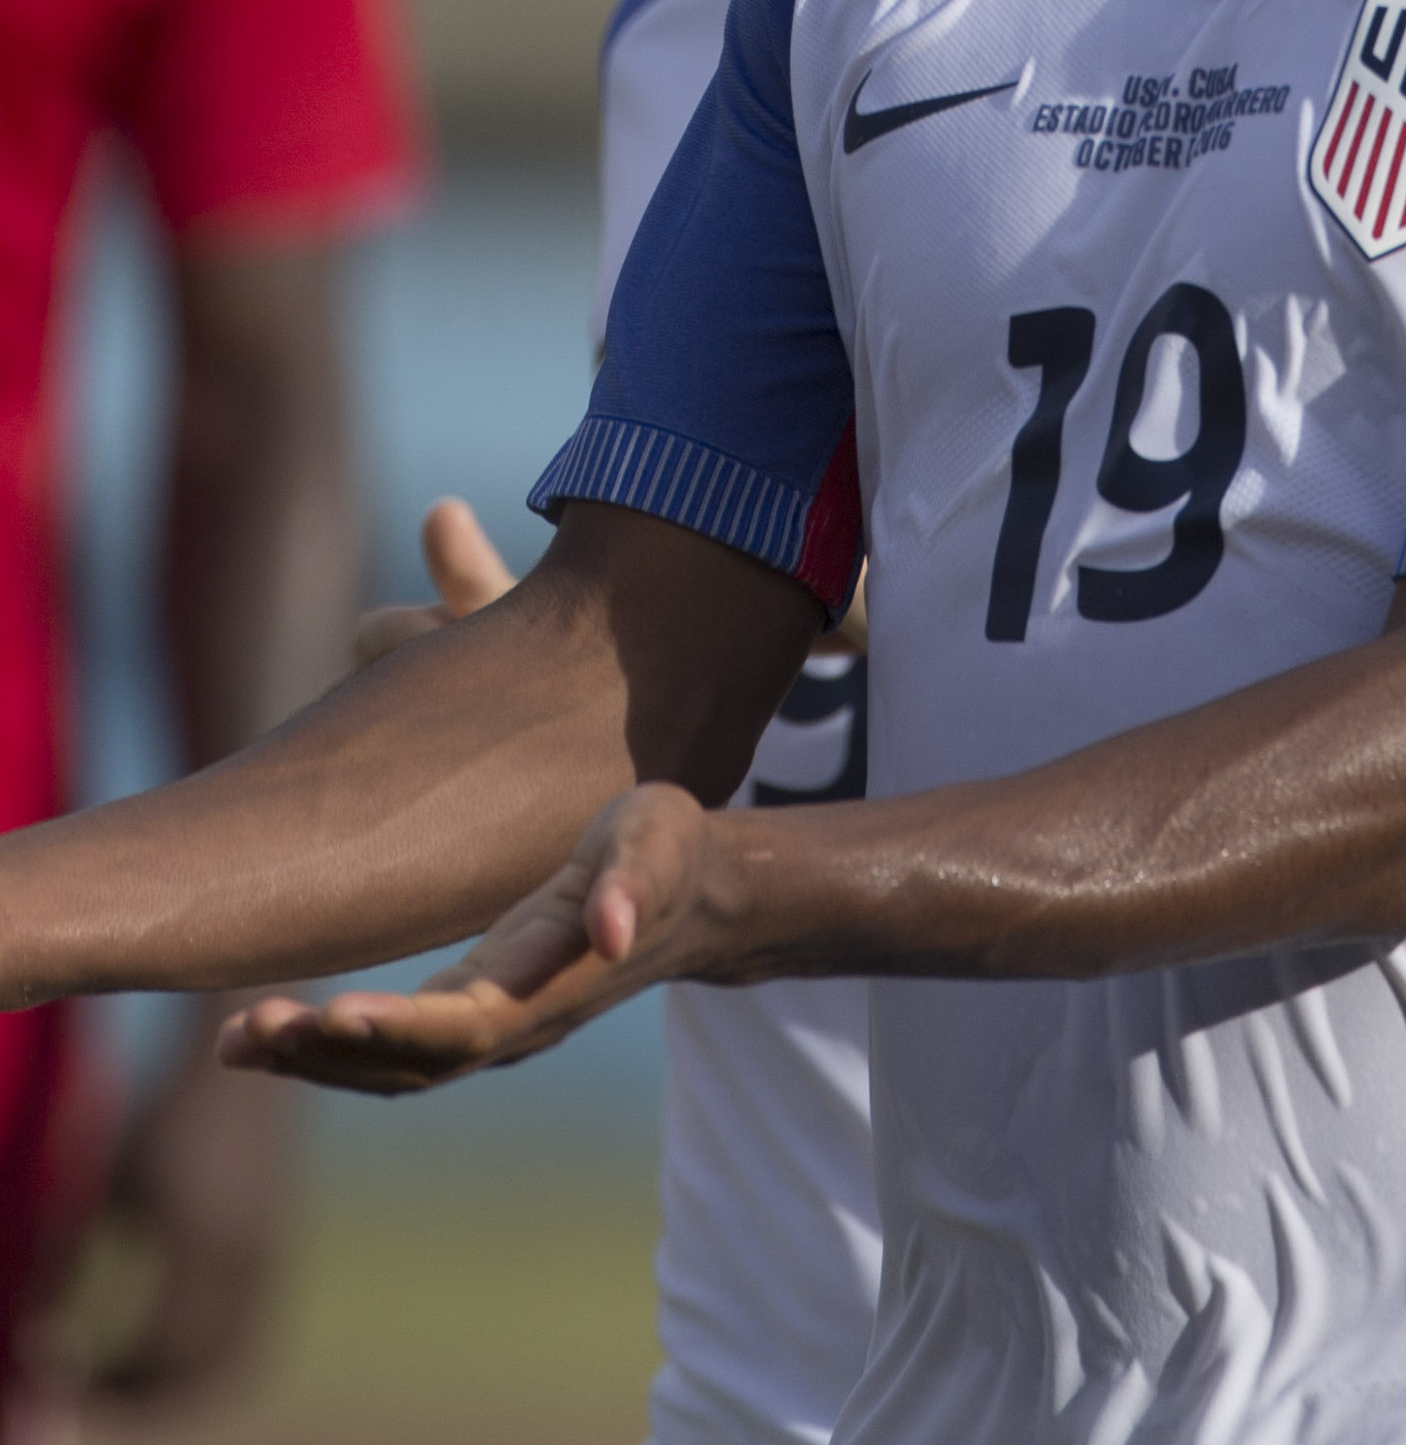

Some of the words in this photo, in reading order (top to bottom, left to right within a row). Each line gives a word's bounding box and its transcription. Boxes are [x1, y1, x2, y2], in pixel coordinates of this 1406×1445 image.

[1032, 103, 1137, 139] ESTADIO
[1137, 101, 1207, 135] EDRO
[985, 282, 1247, 642] 19
